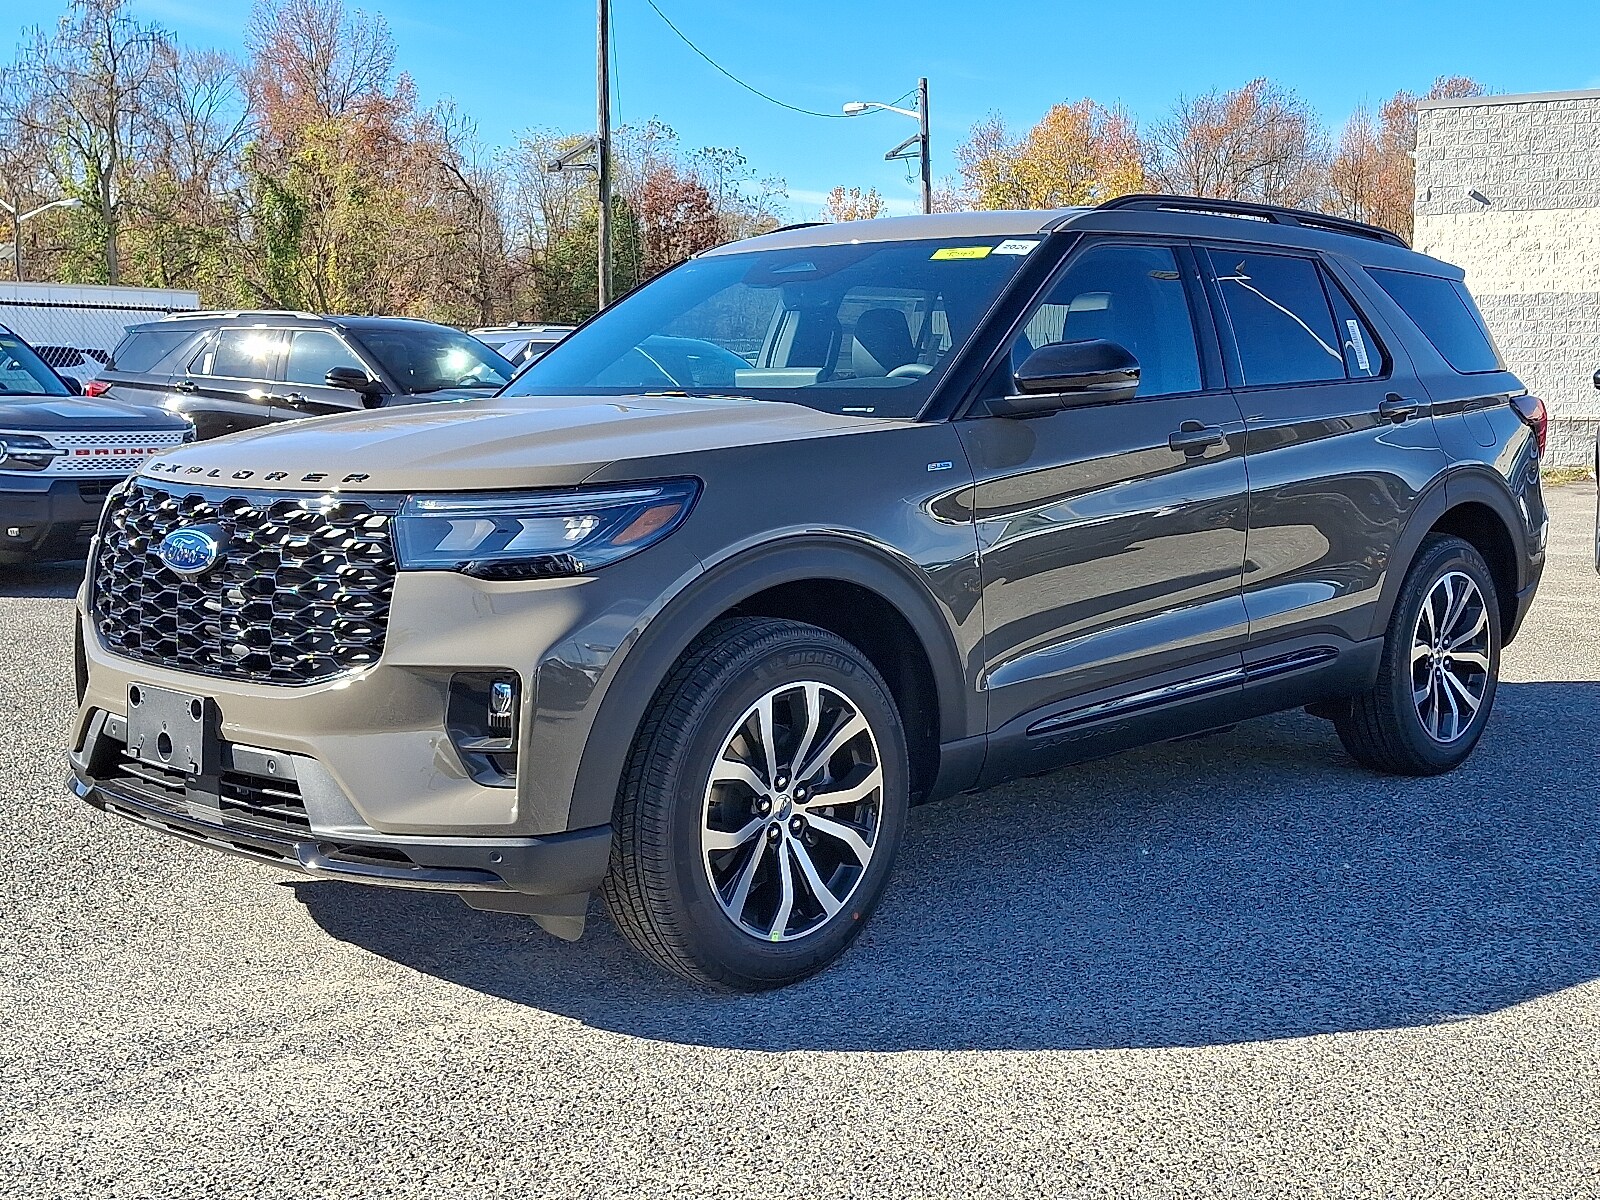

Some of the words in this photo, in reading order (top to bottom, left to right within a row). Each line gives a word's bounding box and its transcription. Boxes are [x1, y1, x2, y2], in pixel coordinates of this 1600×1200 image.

[75, 448, 161, 456] BRONC
[150, 462, 371, 483] EXPLORER
[167, 537, 206, 563] Ford
[786, 652, 854, 672] MICHELIN
